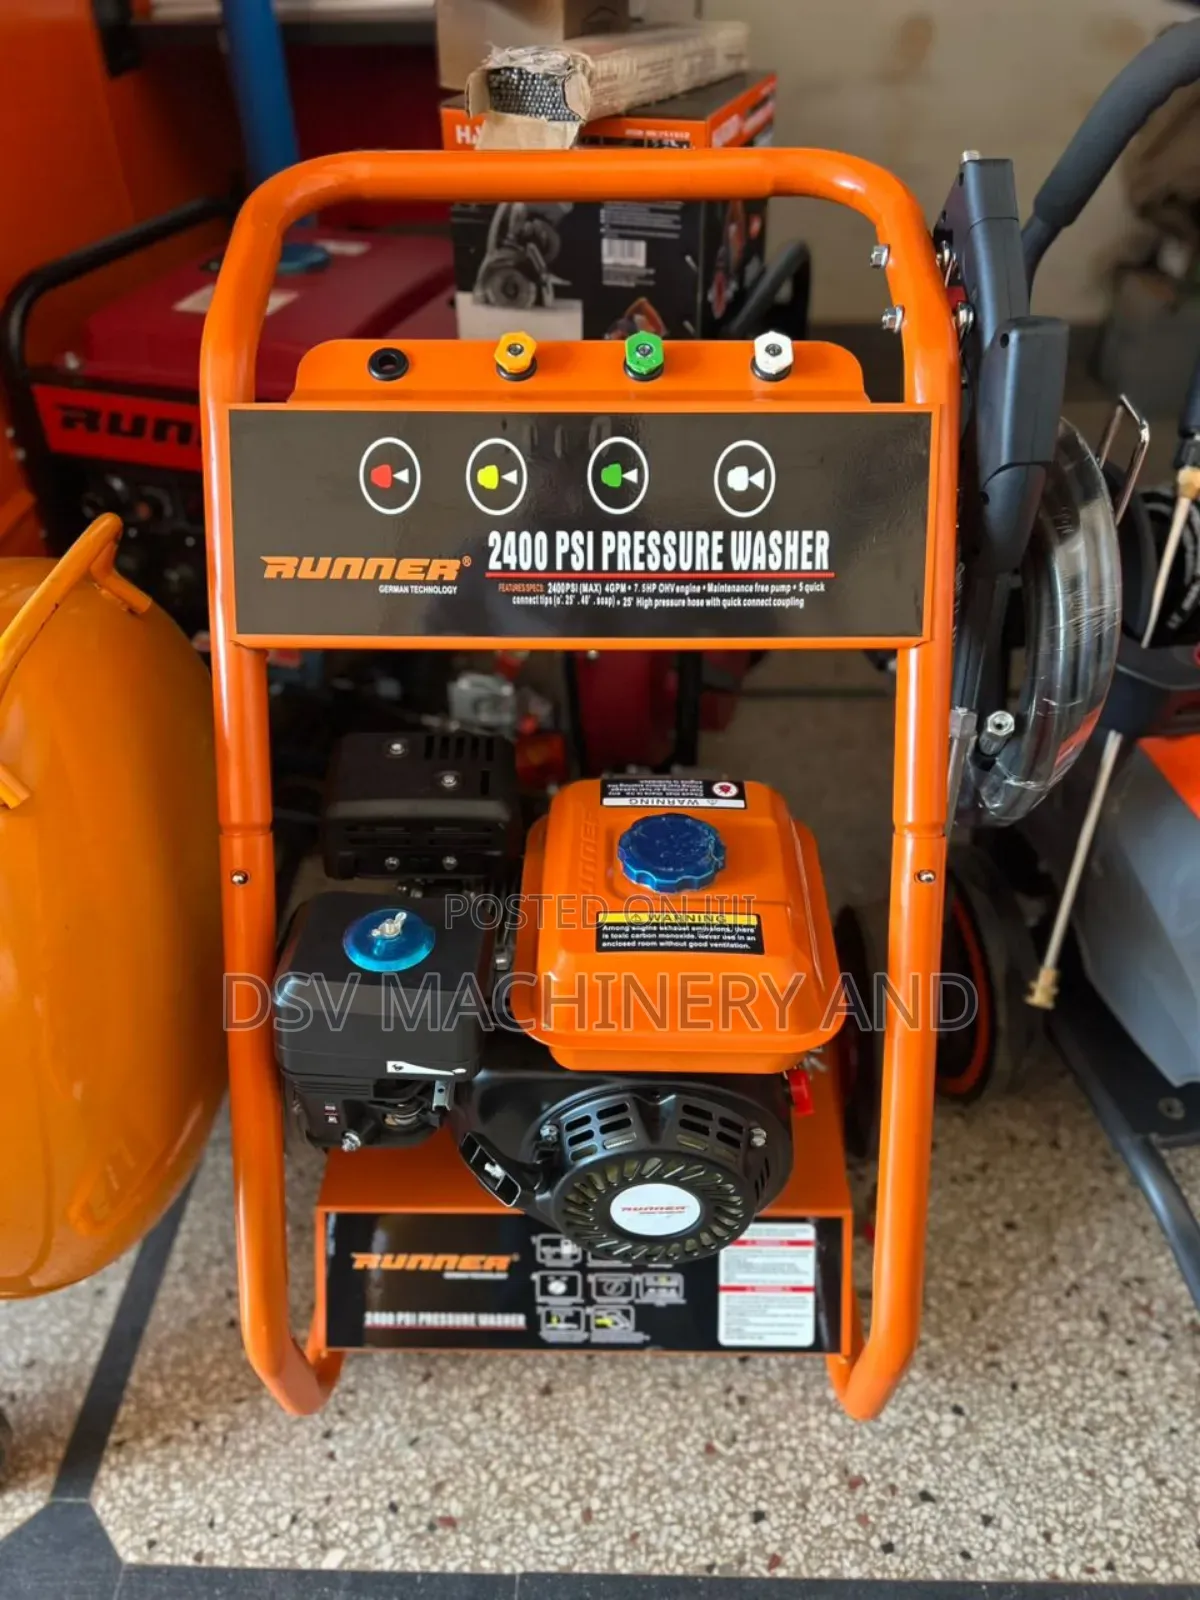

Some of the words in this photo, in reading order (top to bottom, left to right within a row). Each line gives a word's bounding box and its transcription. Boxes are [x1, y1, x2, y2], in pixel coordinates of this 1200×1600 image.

[54, 403, 200, 447] RUN
[488, 530, 548, 571] 2400
[555, 530, 594, 571] PSI
[602, 530, 724, 571] PRESSURE
[730, 530, 830, 571] WASHER
[379, 585, 409, 593] GERMAN
[410, 585, 458, 594] TECHNOLOGY
[605, 582, 626, 593] 4GPM
[675, 582, 700, 596] engine
[707, 582, 753, 593] Maintenance
[755, 581, 769, 593] free
[770, 584, 791, 595] pump
[804, 582, 826, 594] quick
[512, 594, 539, 605] connect
[636, 596, 653, 609] High
[653, 598, 685, 609] pressure
[686, 596, 704, 607] hose
[705, 596, 720, 607] with
[722, 596, 741, 609] quick
[743, 596, 772, 607] connect
[773, 596, 804, 609] coupling
[648, 914, 727, 923] WARNING
[688, 941, 708, 949] good
